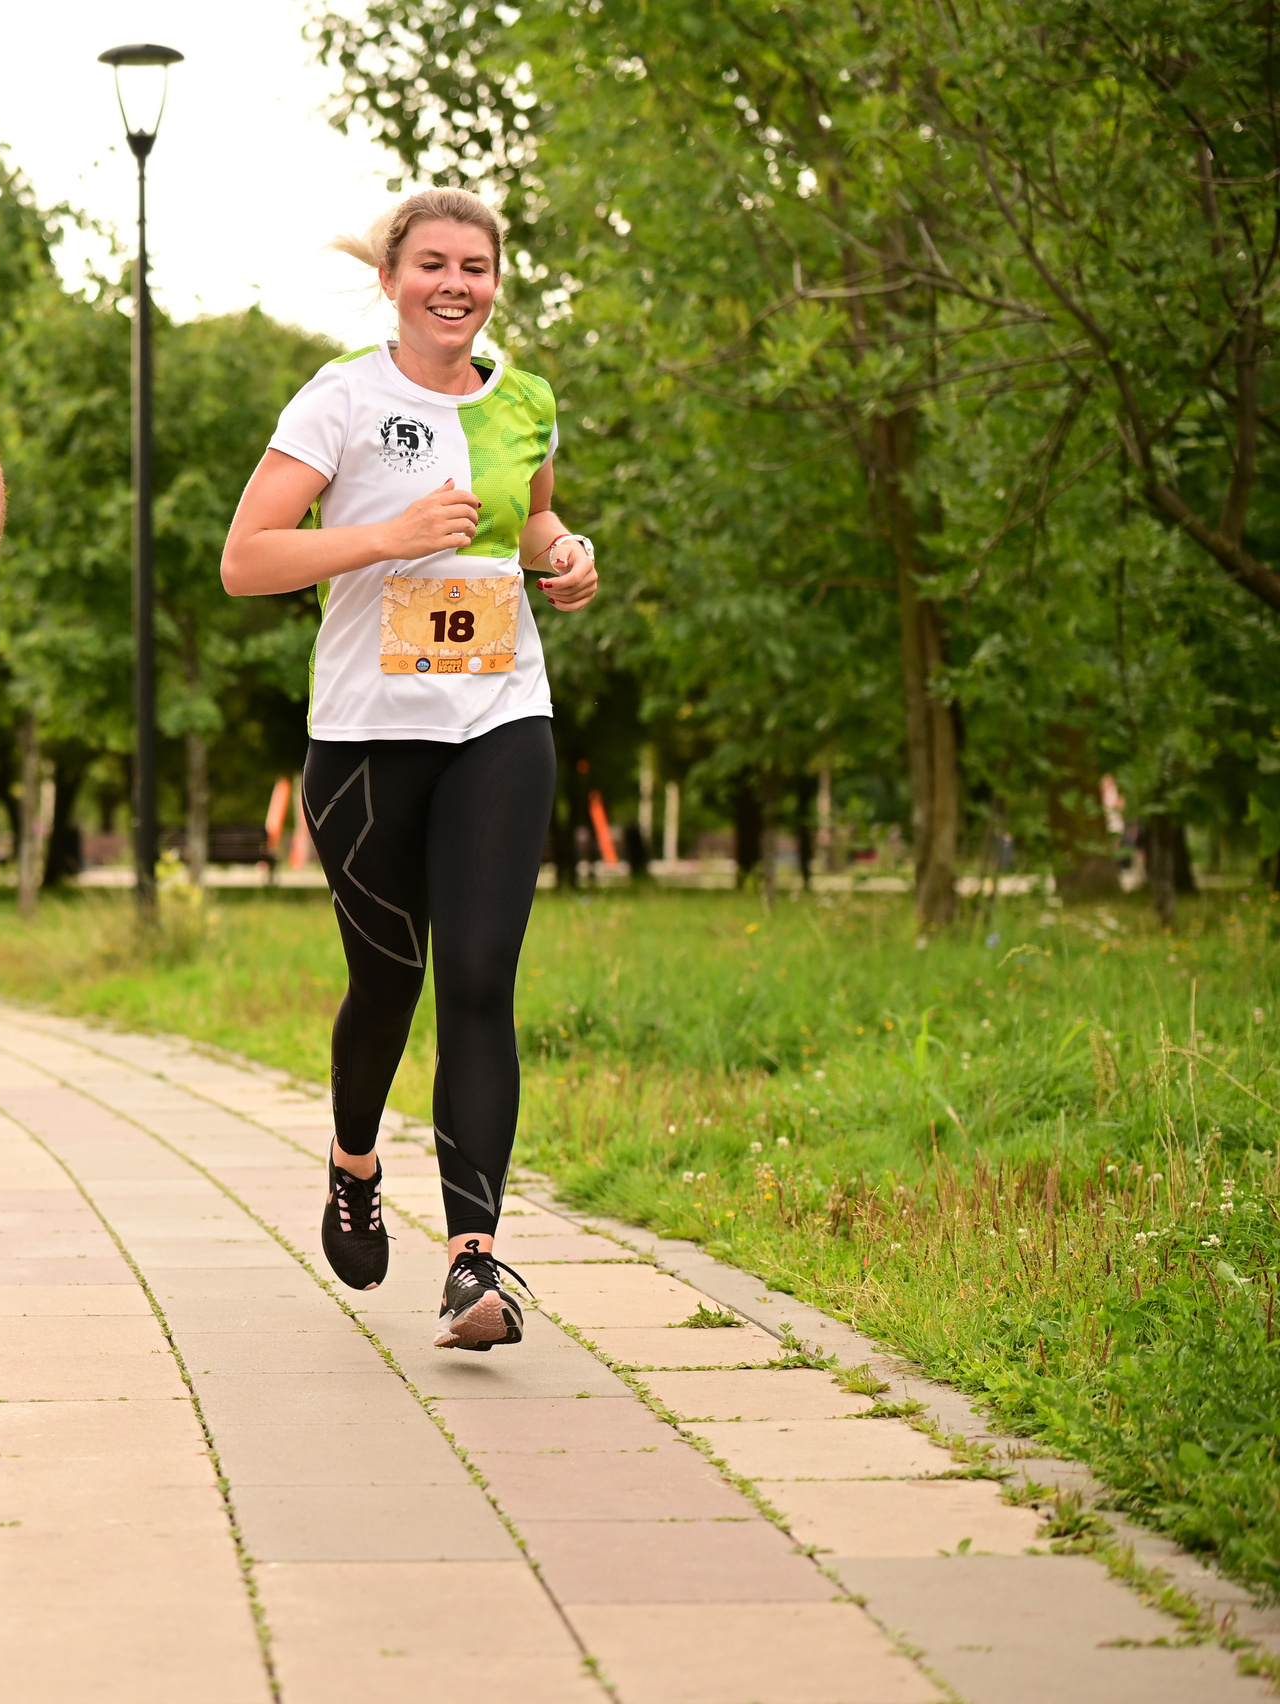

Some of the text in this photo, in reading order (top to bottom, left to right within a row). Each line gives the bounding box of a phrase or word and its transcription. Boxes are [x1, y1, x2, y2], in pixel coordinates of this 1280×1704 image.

[396, 424, 419, 451] 5
[378, 452, 440, 474] ANNIVERSARY
[399, 451, 420, 459] BRUT
[430, 610, 475, 643] 18
